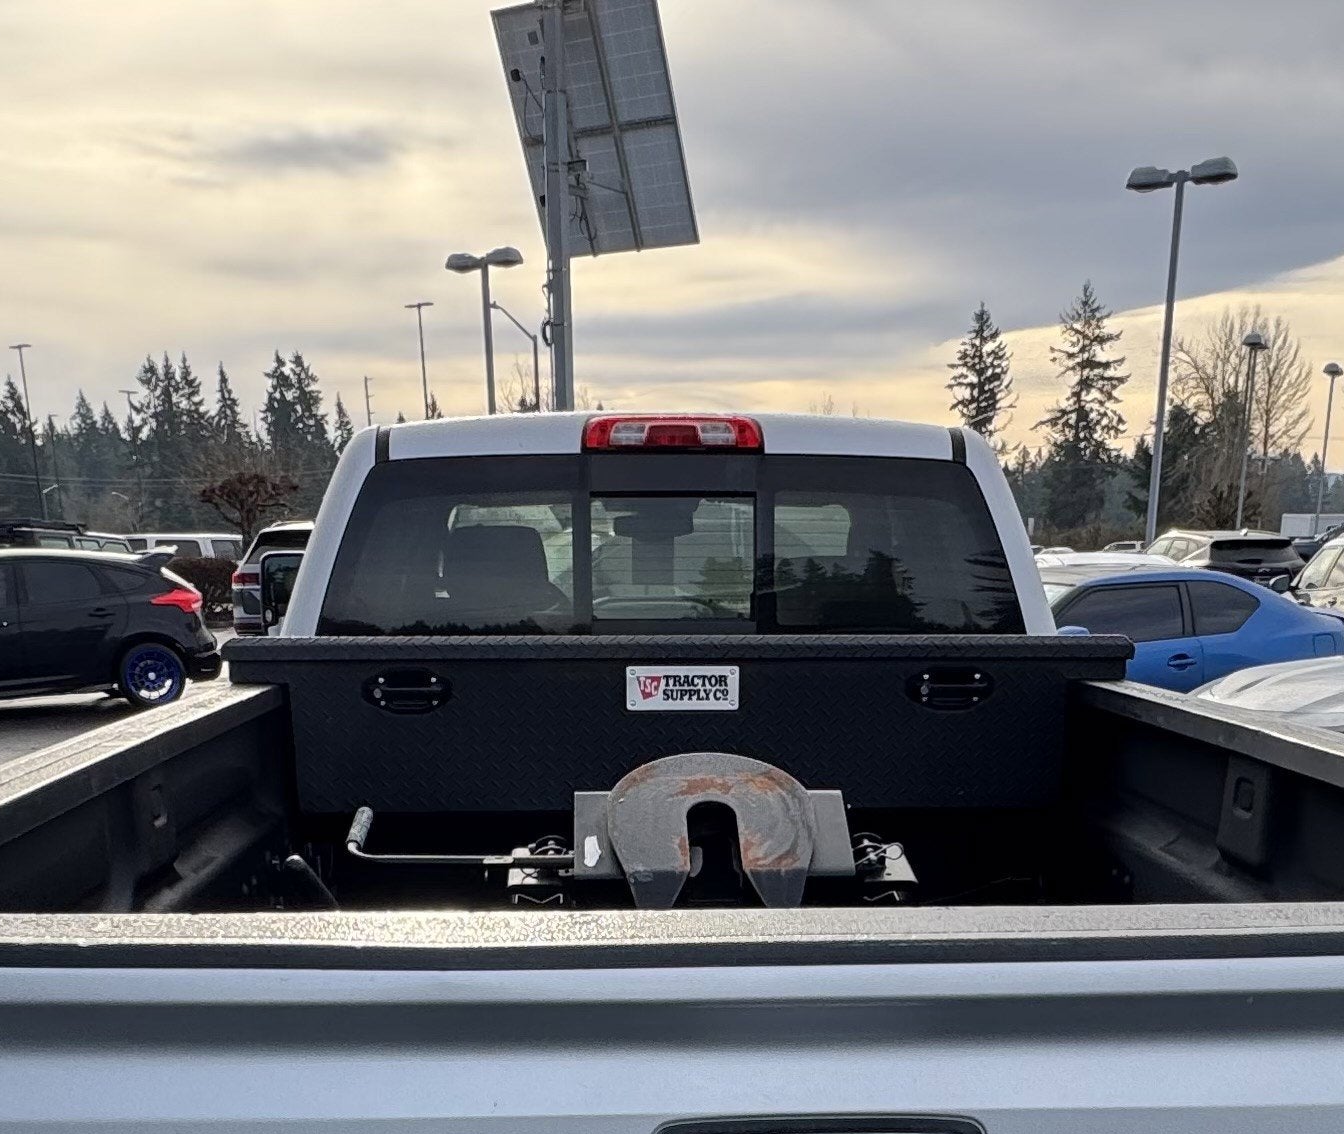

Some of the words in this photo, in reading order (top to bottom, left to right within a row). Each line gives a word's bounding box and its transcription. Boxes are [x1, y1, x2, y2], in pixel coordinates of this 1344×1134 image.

[639, 676, 658, 696] TSC
[662, 674, 729, 688] TRACTOR
[662, 688, 712, 701] SUPPLY
